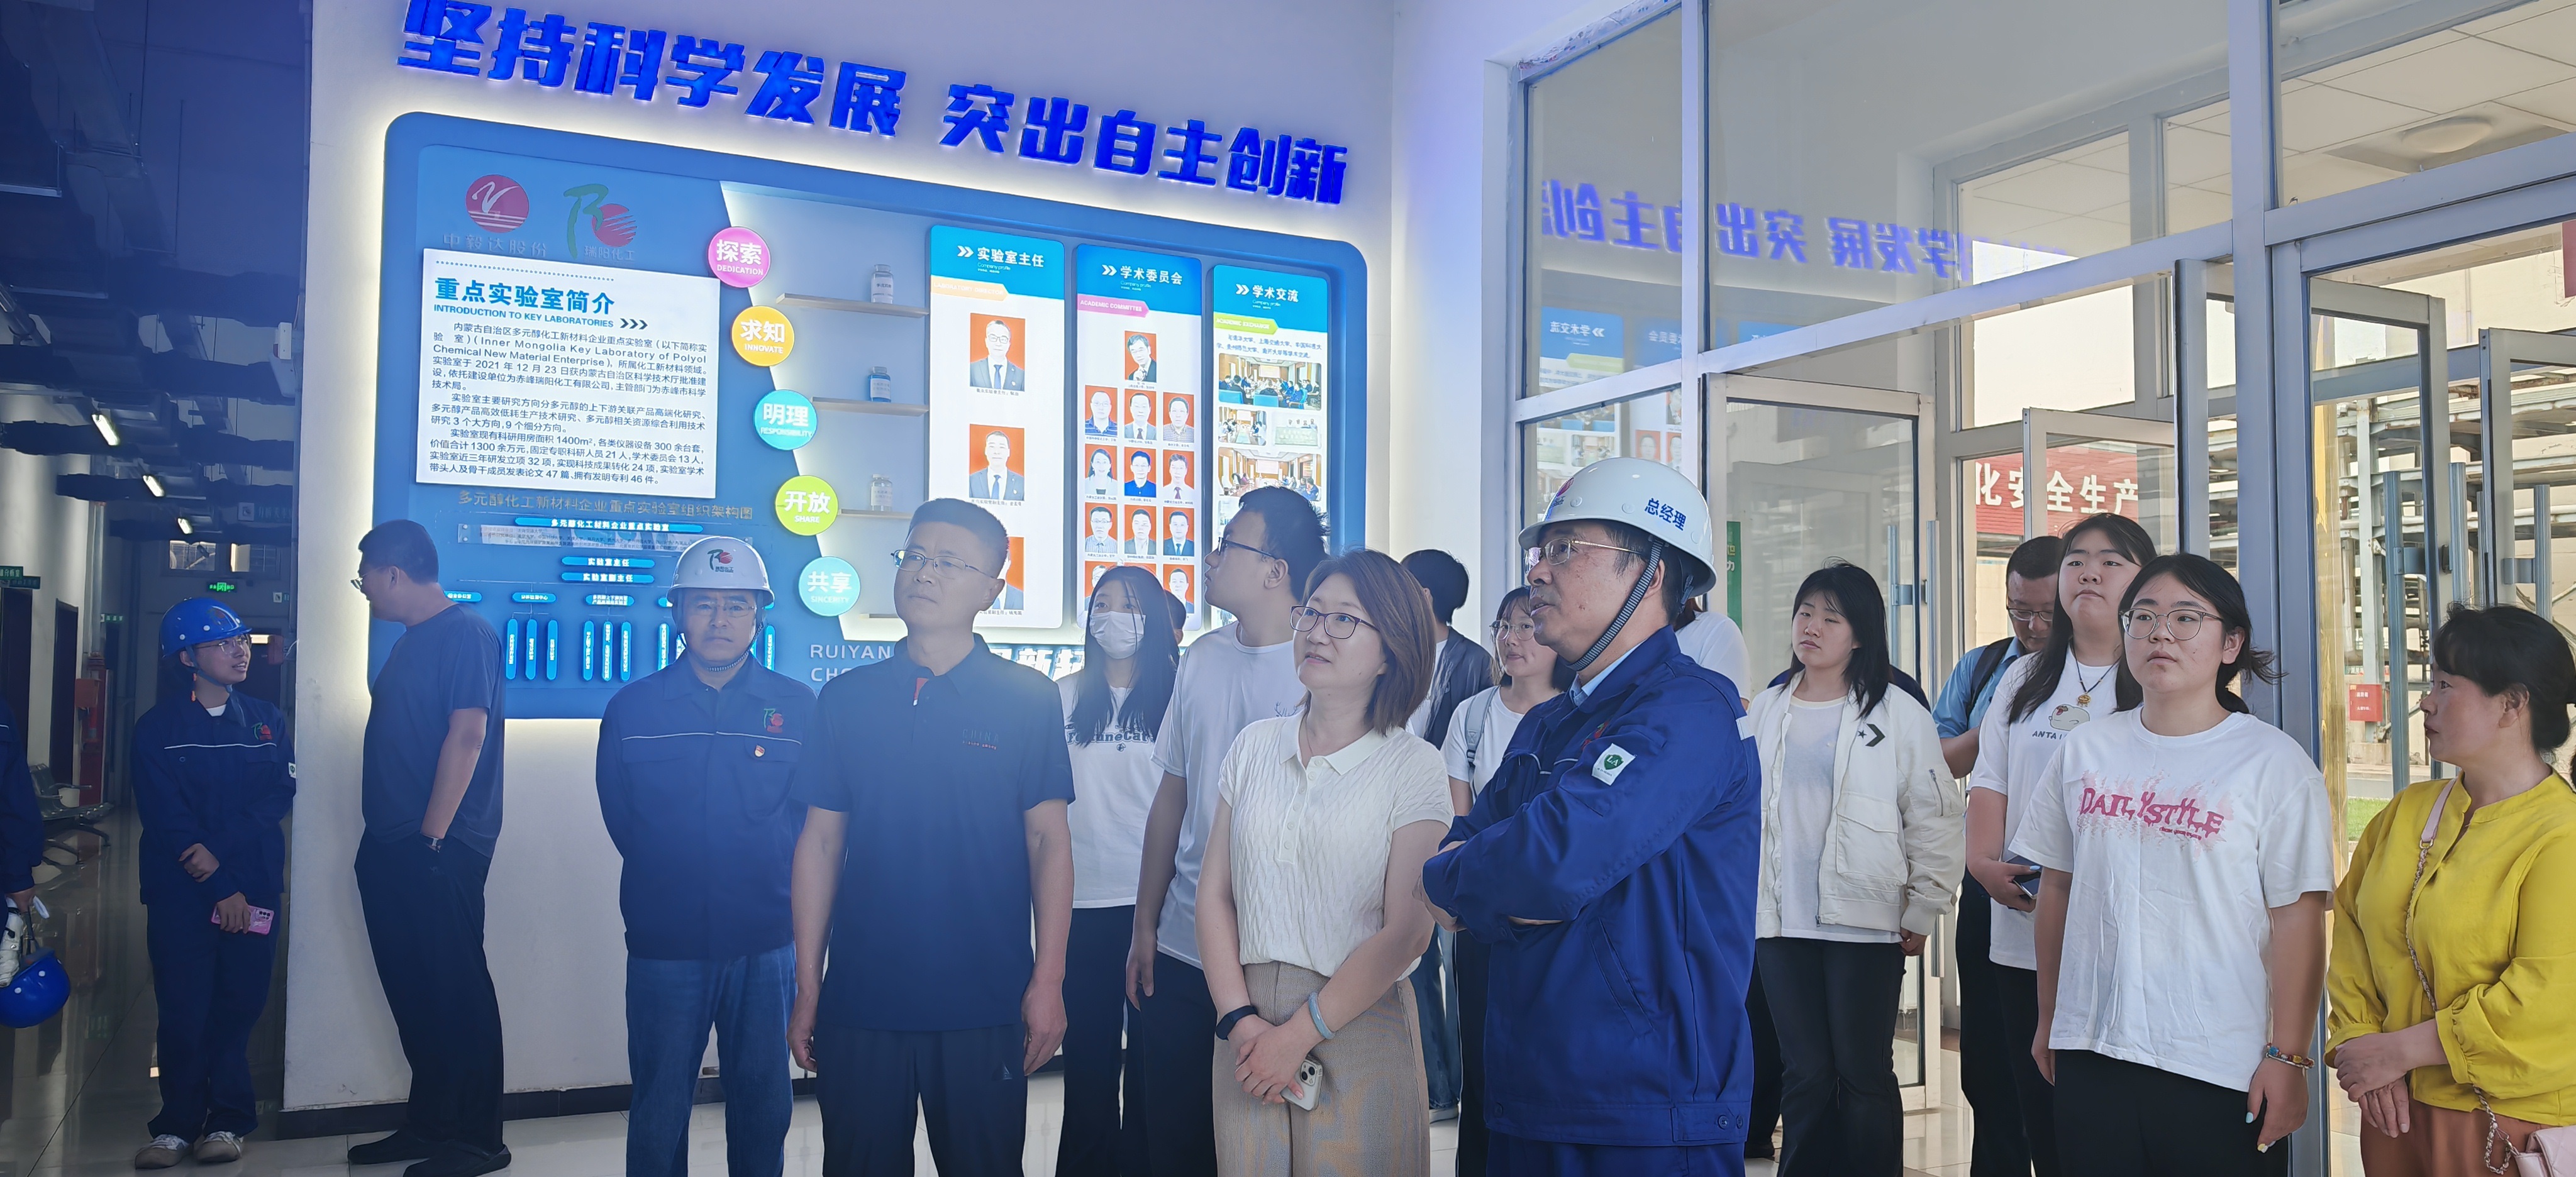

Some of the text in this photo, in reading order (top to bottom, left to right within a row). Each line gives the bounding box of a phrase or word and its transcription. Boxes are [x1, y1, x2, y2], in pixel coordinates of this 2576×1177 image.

[397, 0, 1348, 205] 坚持科学发展 突出自主创新
[443, 233, 547, 258] 中毅达股份
[584, 245, 636, 261] 瑞阳化工
[716, 239, 762, 266] 探索
[977, 246, 1045, 268] 实验室主任
[977, 262, 998, 270] Company
[717, 264, 764, 276] DEDICATION
[1120, 265, 1183, 285] 学术委员会
[435, 277, 615, 315] 重点实验室简介
[933, 282, 972, 292] LABORATORY
[1252, 284, 1299, 303] 学术交流
[1080, 300, 1142, 312] ACADEMIC COMMITTEE
[434, 304, 614, 328] INTRODUCTION TO KEY LABORATORIES
[740, 319, 786, 344] 求知
[433, 332, 443, 341] 验
[570, 345, 591, 355] Key
[595, 346, 655, 360] Laboratory
[673, 353, 706, 363] Polyol
[433, 345, 482, 356] Chemical
[484, 349, 507, 358] New
[509, 351, 550, 362] Material
[745, 343, 784, 355] INNOVATE
[433, 356, 472, 368] 实验室于
[475, 360, 499, 370] 2021
[503, 362, 513, 371] 年
[516, 363, 529, 372] 12
[532, 364, 540, 373] 月
[545, 365, 557, 374] 23
[432, 379, 467, 391] 技术局。
[431, 415, 451, 426] 研究
[453, 417, 459, 425] 3
[514, 421, 567, 433] 个细分方向。
[763, 403, 809, 429] 明理
[450, 429, 553, 444] 实验室现有科研用房面积
[654, 442, 672, 451] 300
[430, 439, 469, 450] 价值合计
[471, 442, 495, 451] 1300
[606, 451, 616, 459] 21
[679, 455, 690, 463] 13
[430, 451, 526, 465] 实验室近三年研发立项
[528, 457, 540, 466] 32
[631, 463, 644, 472] 24
[430, 463, 544, 477] 带头人及骨干成员发表论文
[546, 470, 557, 478] 47
[630, 475, 643, 483] 46
[458, 490, 753, 519] 多元醇化工新材料企业重点实验室组织架构图
[784, 490, 831, 514] 开放
[794, 515, 820, 524] SHARE
[1644, 497, 1687, 531] 总经理
[550, 518, 670, 532] 多元醇化工材料企业重点实验室
[587, 558, 630, 566] 实验室主任
[583, 573, 633, 582] 实验室副主任
[807, 570, 853, 594] 共享
[810, 594, 850, 605] SINCERITY
[2032, 731, 2057, 740] ANTA
[1606, 755, 1619, 767] LA
